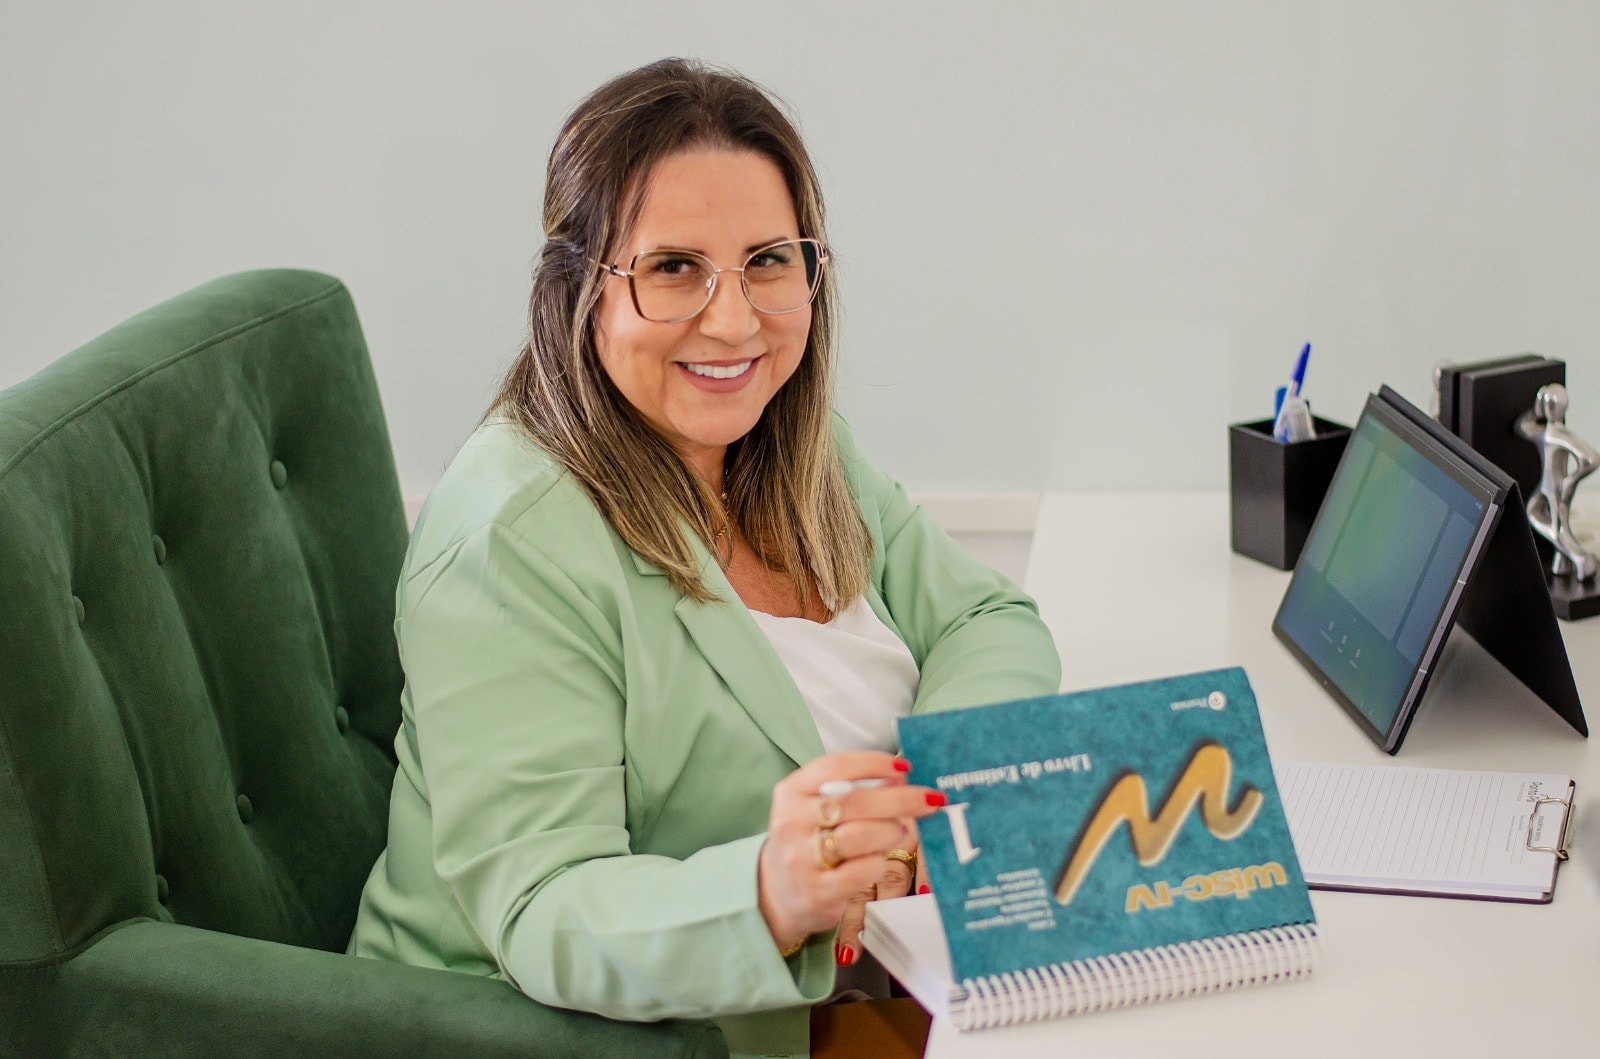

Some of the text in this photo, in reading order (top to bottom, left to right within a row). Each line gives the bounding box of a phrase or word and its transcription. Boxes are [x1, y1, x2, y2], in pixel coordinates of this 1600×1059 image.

[1020, 761, 1042, 779] de
[1043, 753, 1092, 773] Livro
[940, 802, 981, 865] 1
